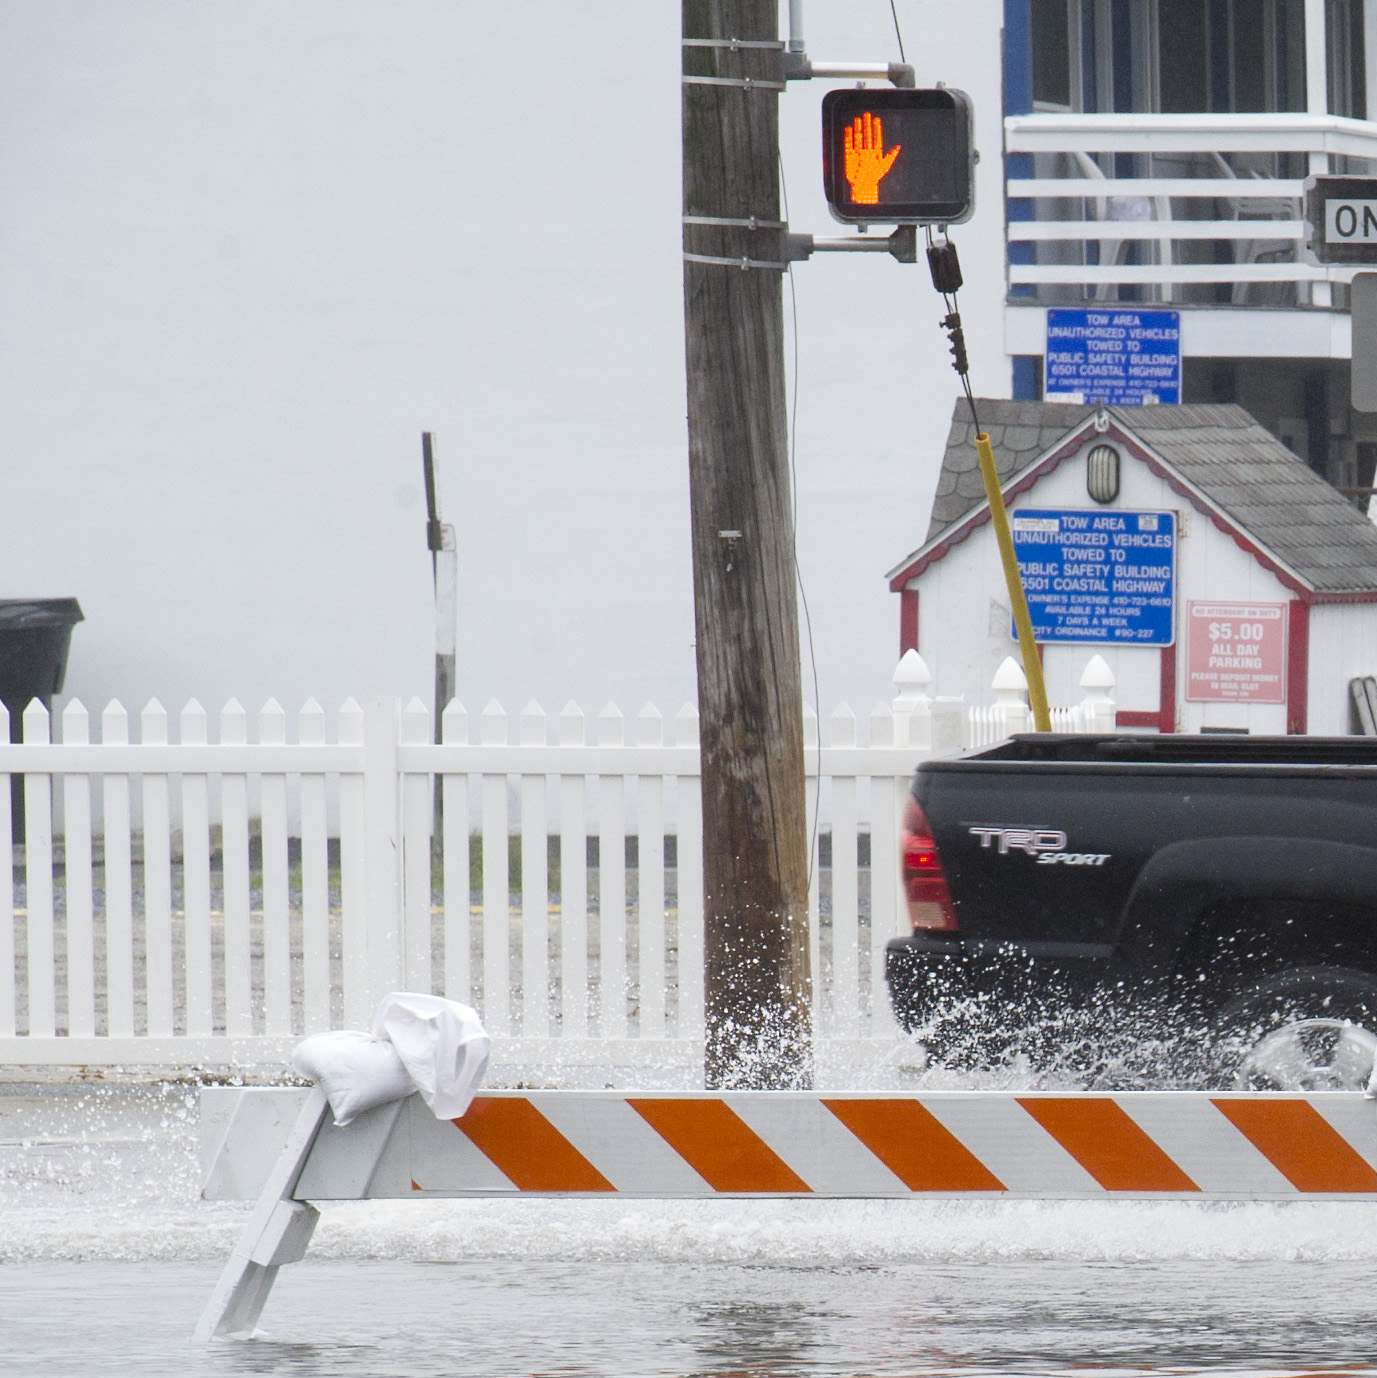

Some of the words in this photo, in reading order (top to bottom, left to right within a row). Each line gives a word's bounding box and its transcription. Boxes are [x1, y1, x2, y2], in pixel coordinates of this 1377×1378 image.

[1087, 314, 1110, 326] TOW
[1112, 314, 1141, 326] AREA
[1047, 326, 1126, 339] UNAUTHORIZED
[1128, 328, 1178, 340] VEHICLES
[1087, 340, 1123, 351] TOWED
[1127, 341, 1141, 352] TO
[1048, 352, 1085, 363] PUBLIC
[1087, 353, 1128, 364] SAFETY
[1129, 354, 1178, 365] BUILDING
[1051, 365, 1077, 376] 6501
[1079, 365, 1126, 376] COASTAL
[1128, 366, 1174, 377] HIGHWAY
[1060, 516, 1090, 529] TOW
[1092, 517, 1126, 530] AREA
[1014, 531, 1108, 545] UNAUTHORIZED
[1112, 534, 1173, 548] VEHICLES
[1061, 547, 1105, 561] TOWED
[1110, 548, 1126, 562] TO
[1063, 563, 1111, 577] SAFETY
[1115, 565, 1171, 579] BUILDING
[1053, 578, 1109, 592] COASTAL
[1112, 580, 1167, 594] HIGHWAY
[1070, 595, 1110, 605] EXPENSE
[1045, 605, 1092, 615] AVAILABLE
[1094, 606, 1106, 615] 24
[1109, 607, 1141, 617] HOURS
[1066, 616, 1089, 626] DAYS
[1091, 617, 1099, 626] A
[1101, 617, 1128, 627] WEEK
[1054, 627, 1107, 638] ORDINANCE
[1208, 622, 1264, 641] $5.00
[1212, 643, 1233, 656] ALL
[1237, 644, 1260, 656] DAY
[1209, 655, 1263, 669] PARKING
[968, 827, 1068, 855] TRD
[1036, 852, 1113, 866] SPORT
